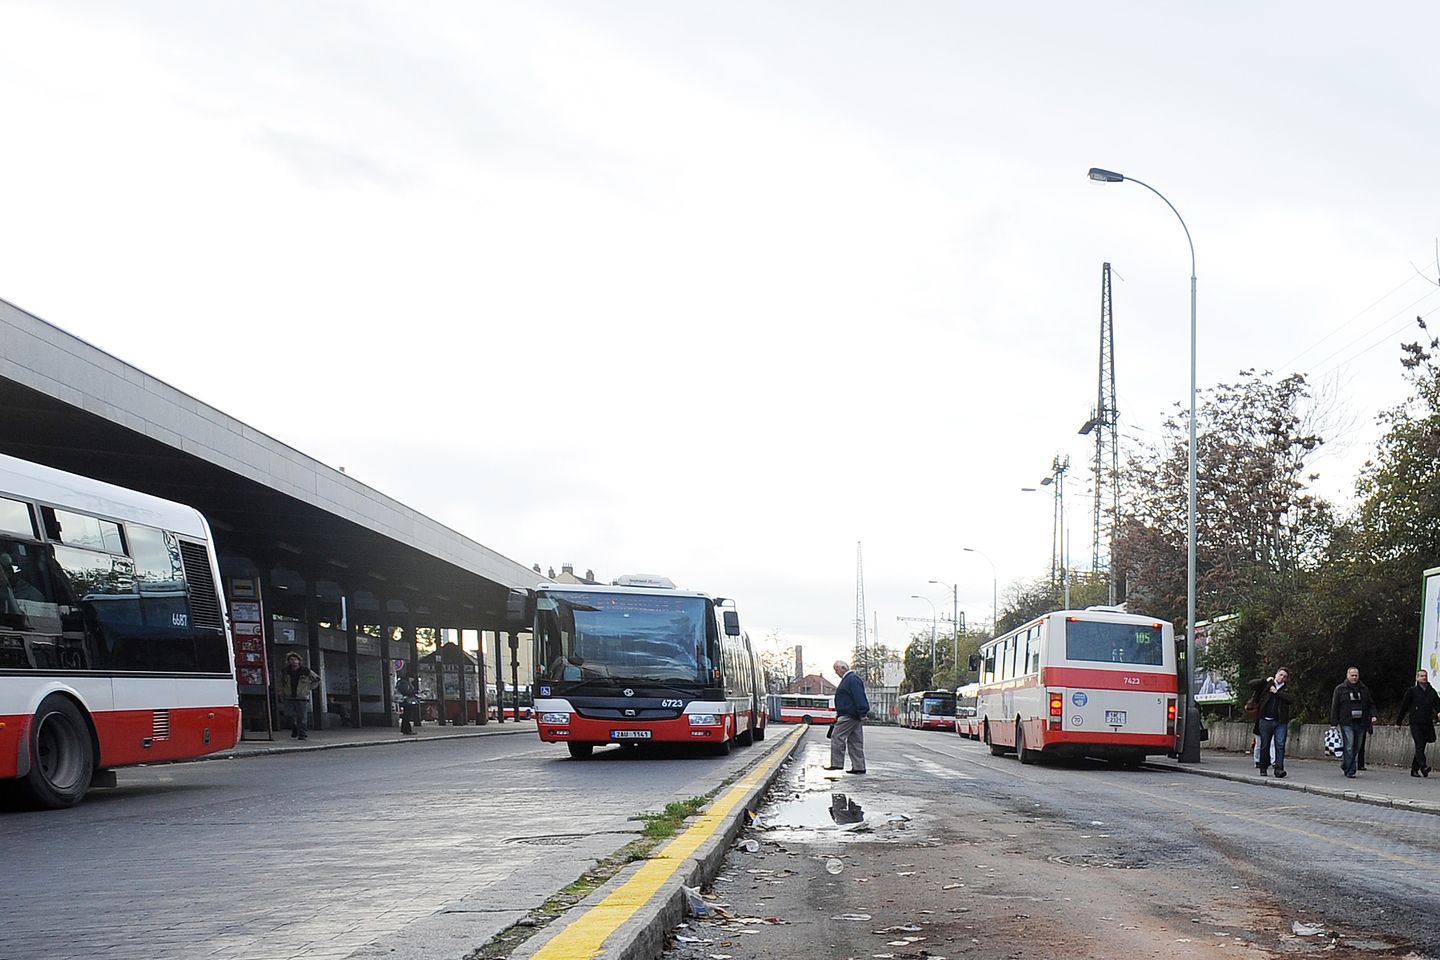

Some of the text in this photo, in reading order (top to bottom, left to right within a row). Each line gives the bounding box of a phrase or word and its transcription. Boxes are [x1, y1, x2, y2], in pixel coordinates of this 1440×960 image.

[172, 613, 188, 626] 6687
[1135, 632, 1151, 644] 105
[661, 699, 683, 708] 6723
